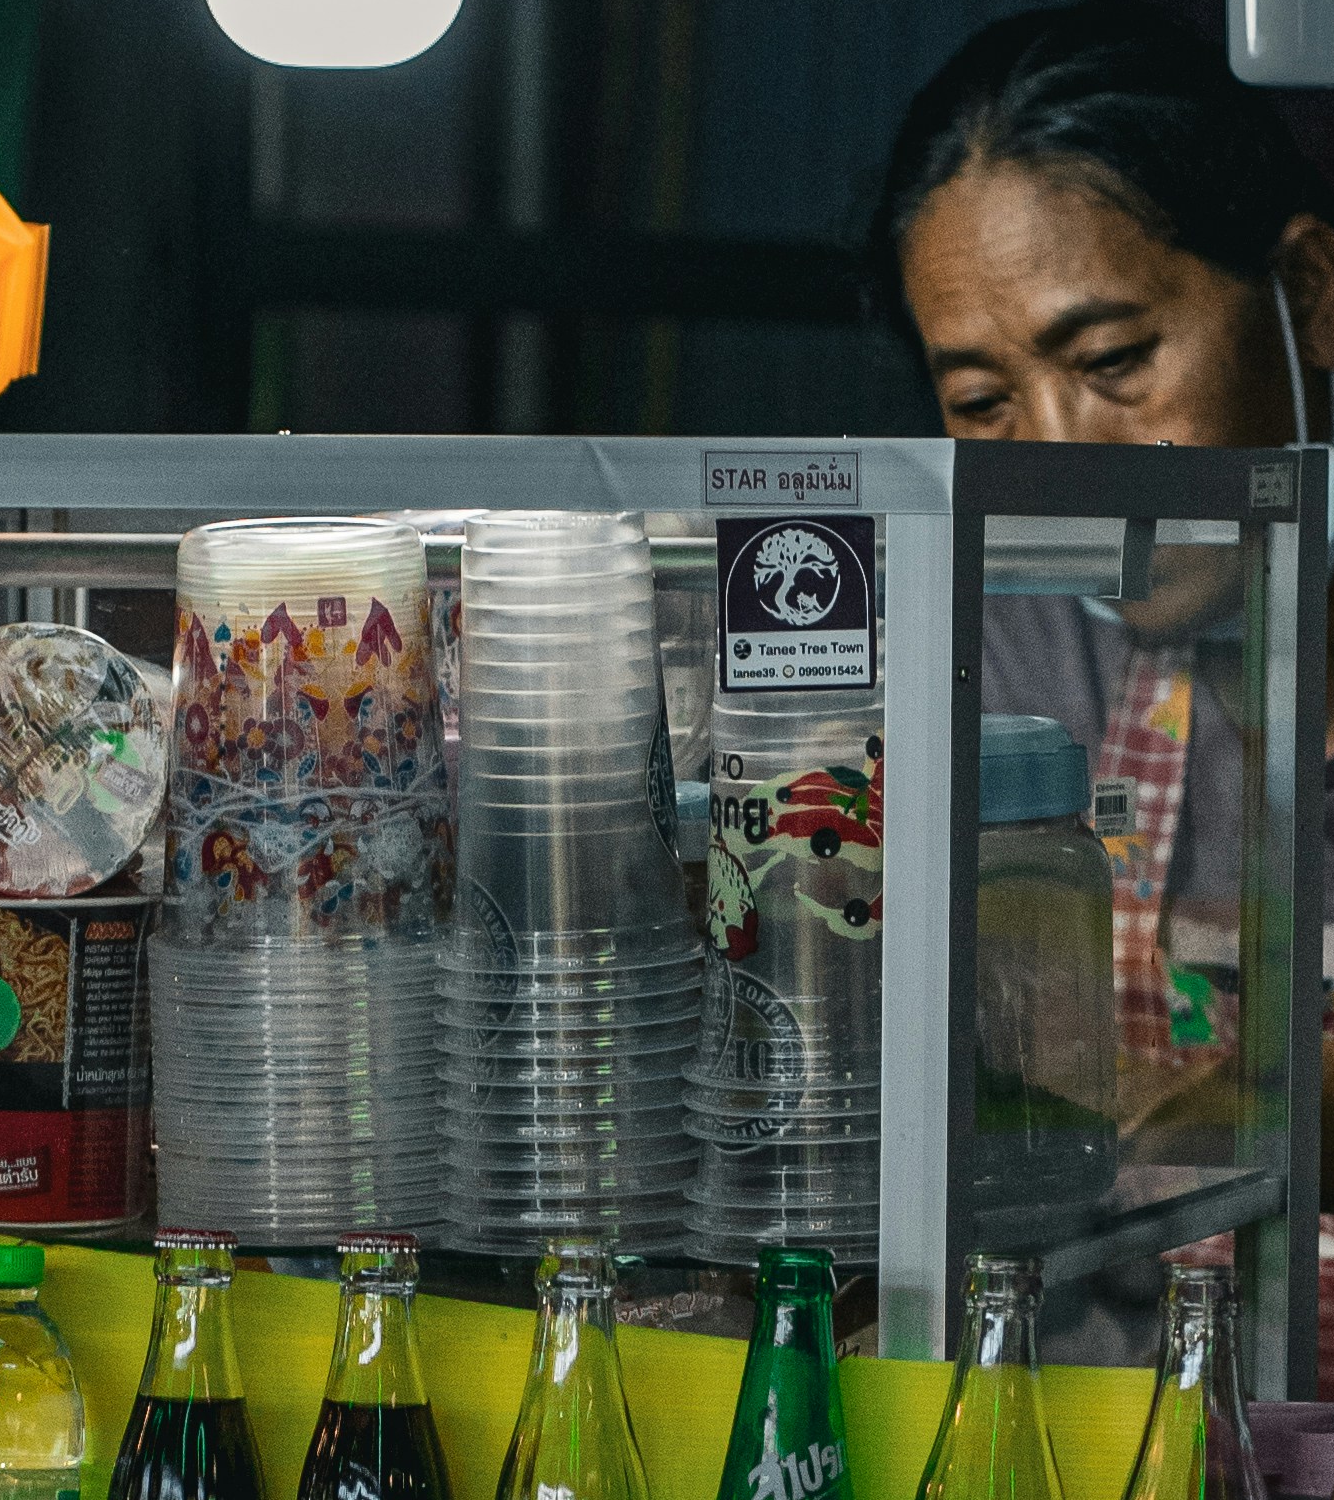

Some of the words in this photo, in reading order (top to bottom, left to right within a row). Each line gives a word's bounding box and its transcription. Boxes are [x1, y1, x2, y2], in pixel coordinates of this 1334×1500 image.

[711, 468, 767, 490] STAR
[778, 457, 851, 500] อลูมินั่ม
[758, 644, 797, 656] Tanee
[800, 643, 828, 655] Tree
[831, 641, 864, 654] Town
